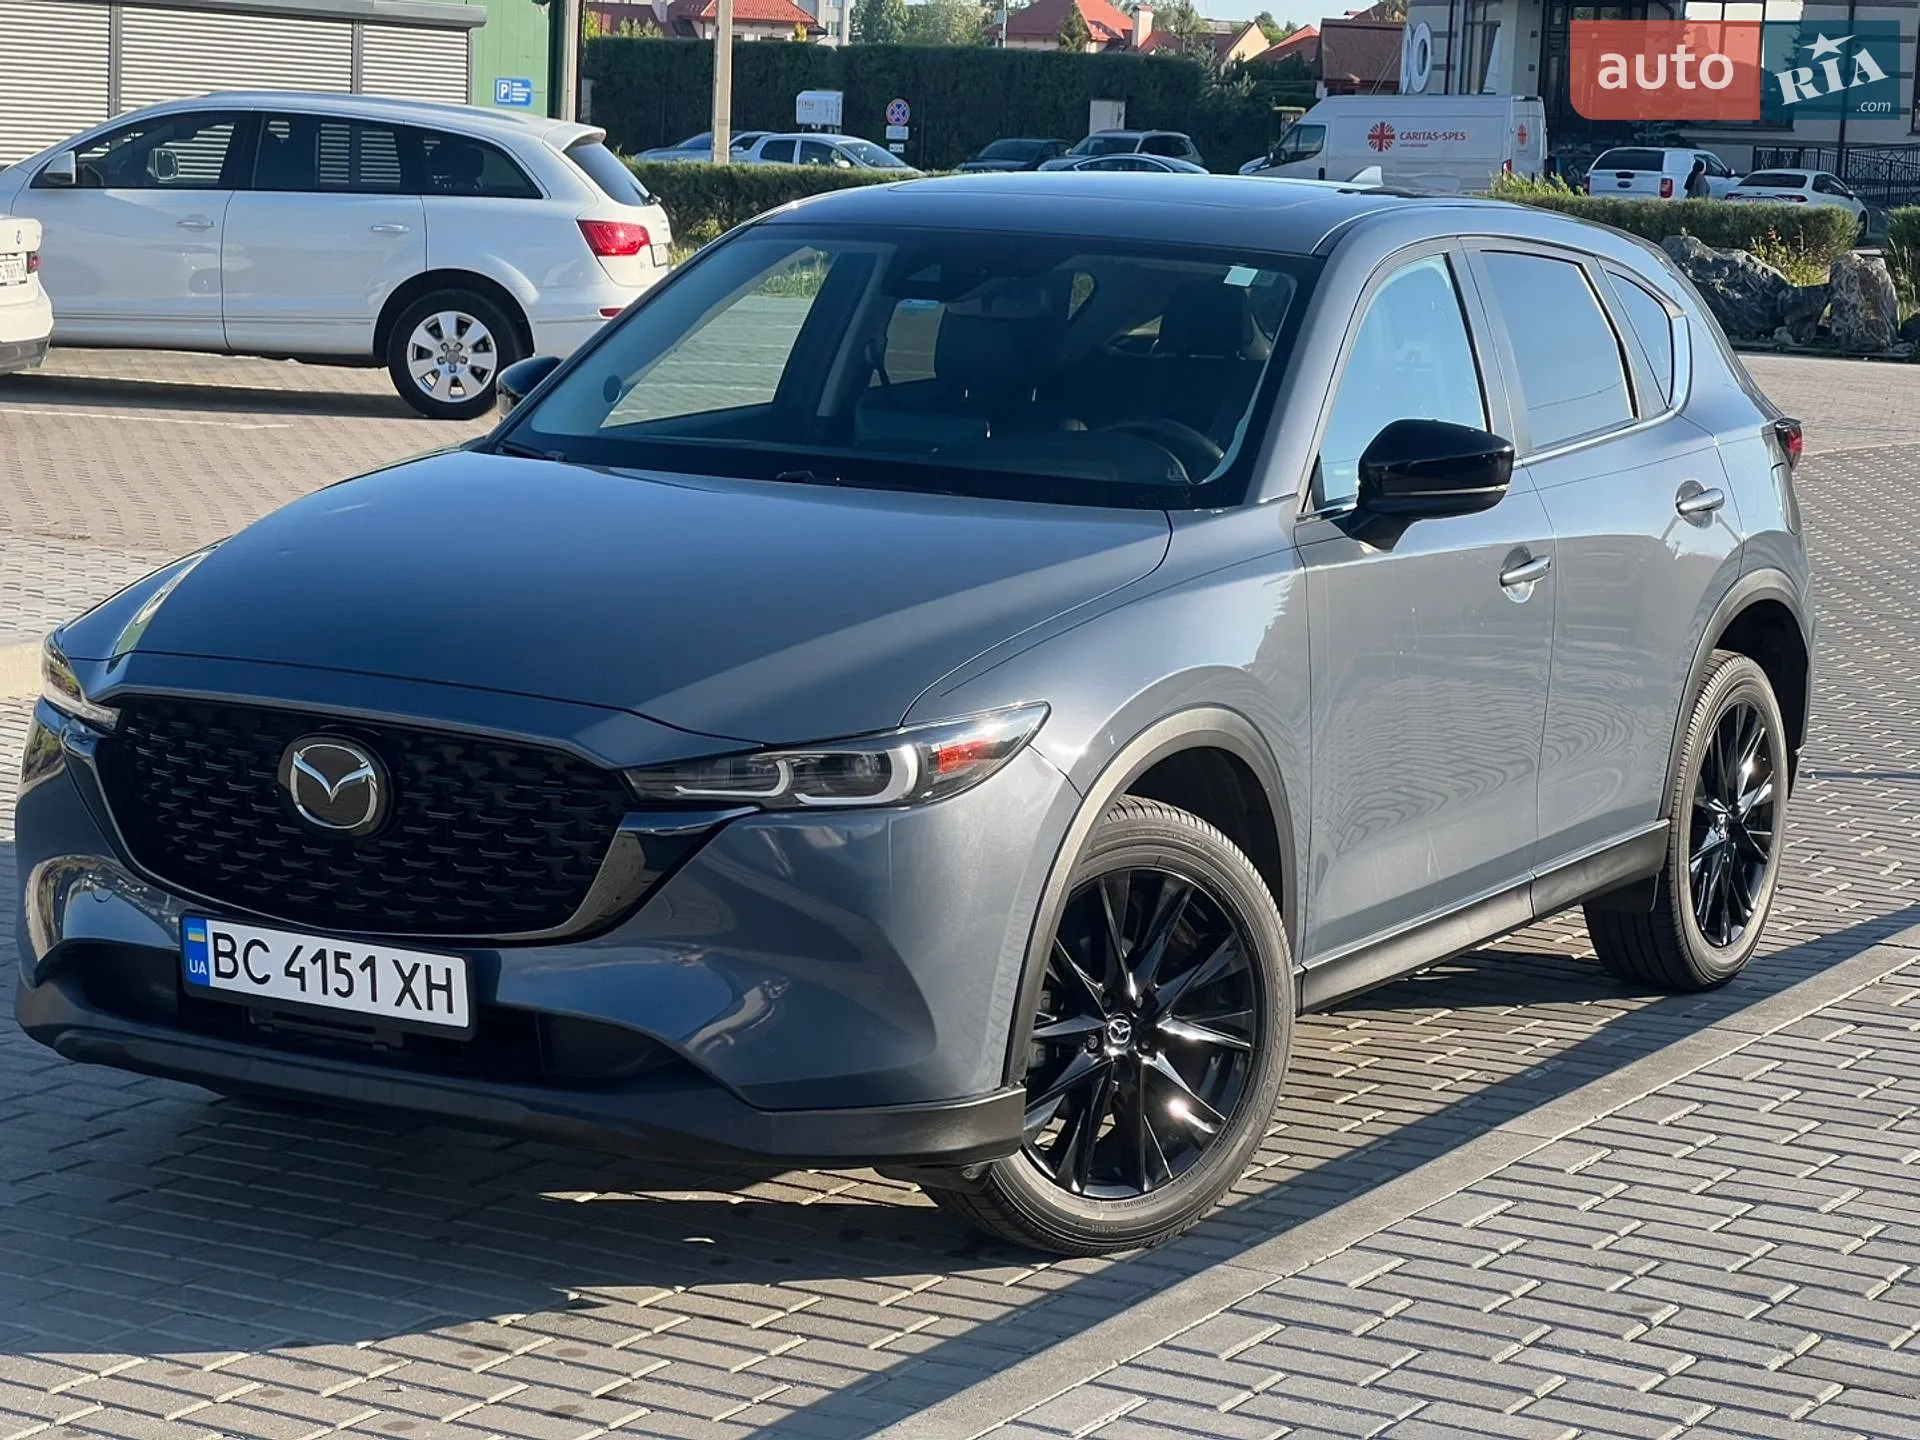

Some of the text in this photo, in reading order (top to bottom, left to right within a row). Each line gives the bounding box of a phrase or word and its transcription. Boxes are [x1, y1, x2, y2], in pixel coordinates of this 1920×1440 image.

[500, 83, 508, 99] P
[189, 959, 207, 975] UA
[212, 932, 454, 1014] BC 4151 XH
